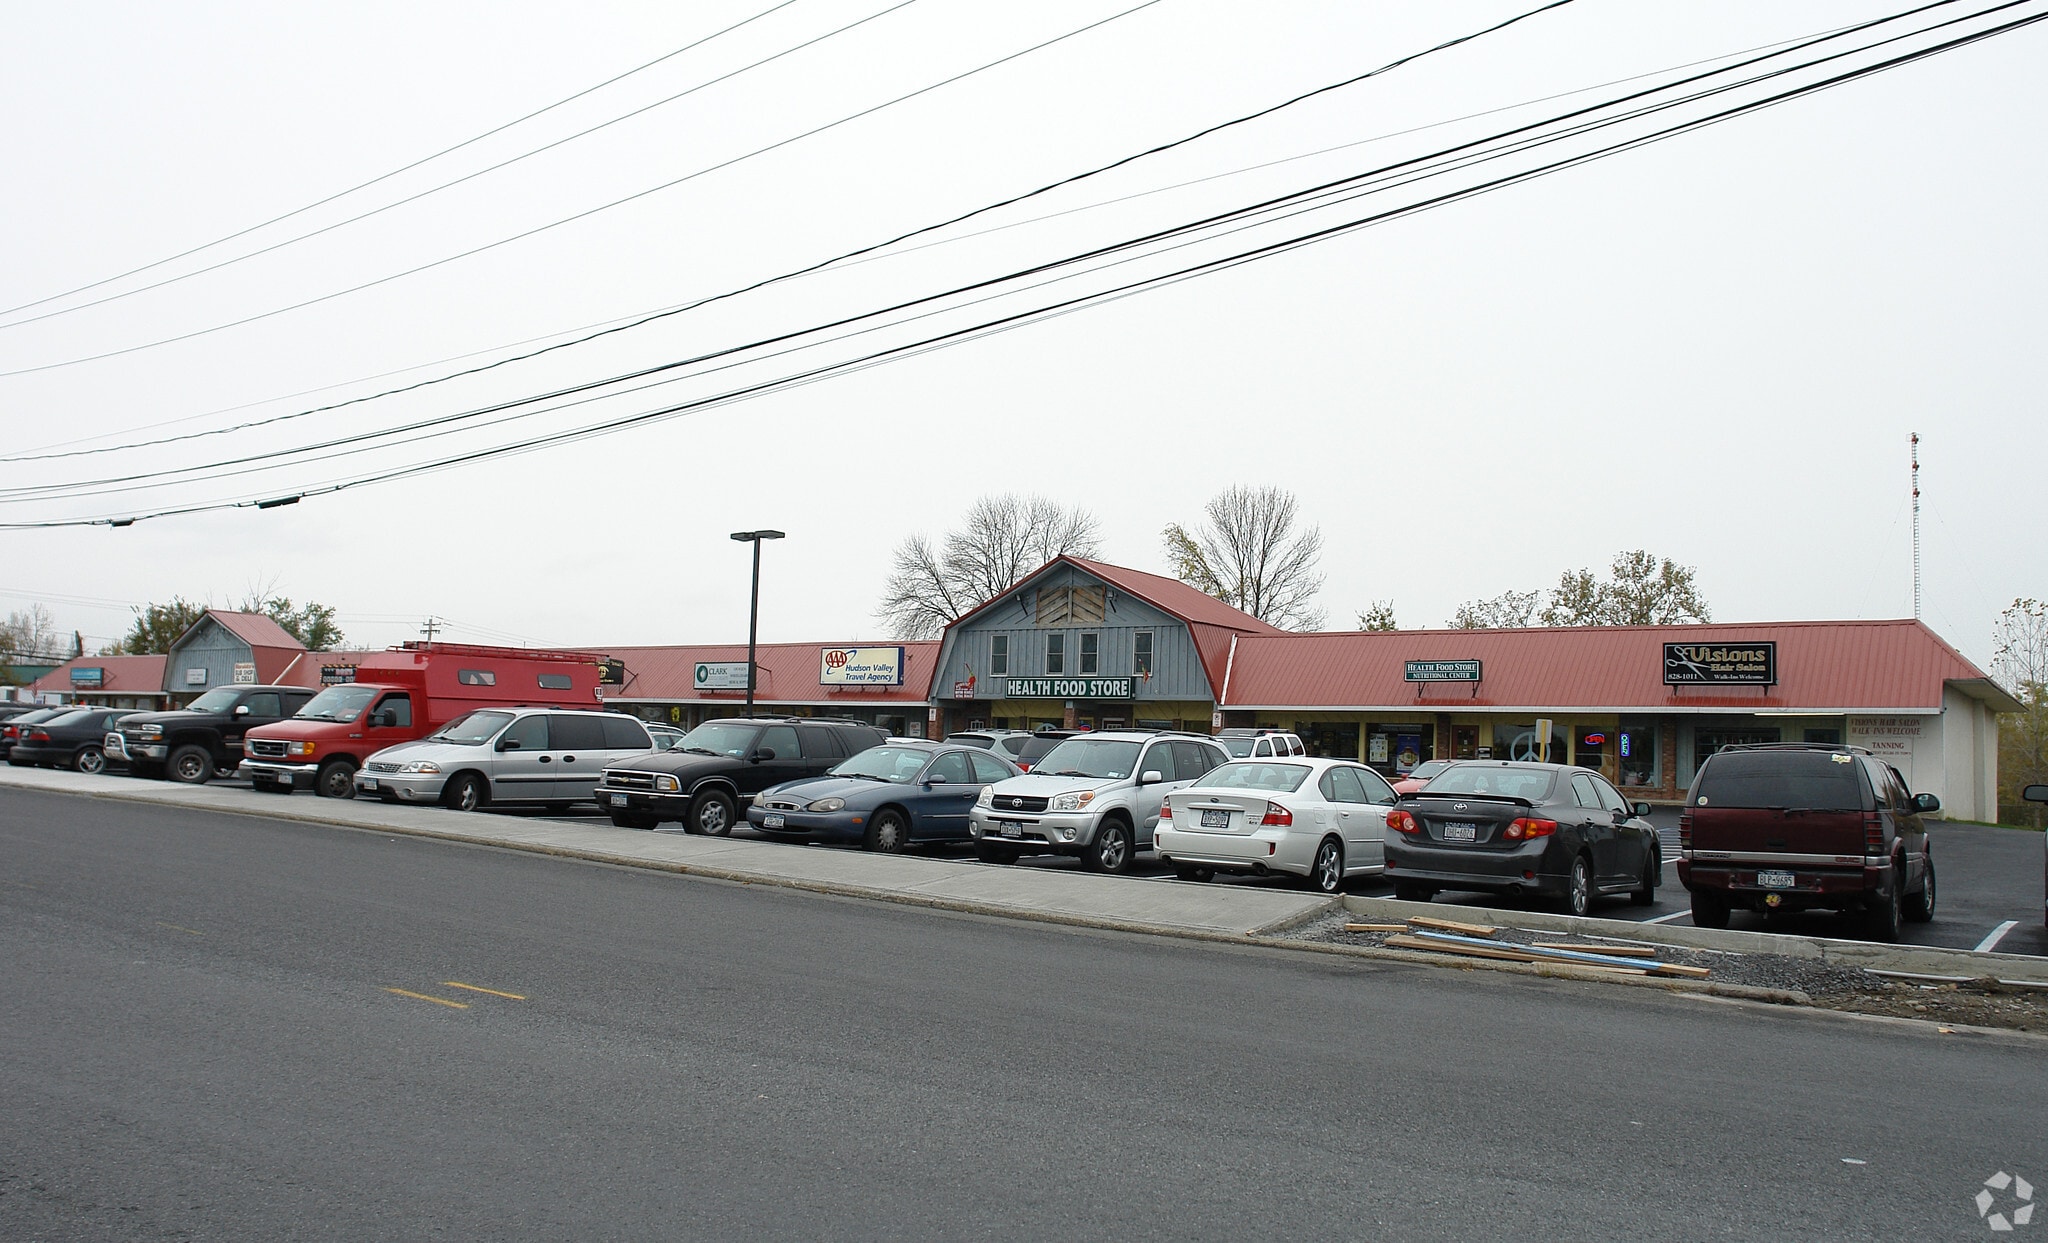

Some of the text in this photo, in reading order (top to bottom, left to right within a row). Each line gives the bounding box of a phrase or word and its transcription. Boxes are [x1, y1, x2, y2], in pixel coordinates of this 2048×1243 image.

[1684, 646, 1766, 662] Visions
[826, 652, 847, 667] AAA
[708, 667, 728, 676] CLARK
[845, 663, 895, 674] Hudson Valley
[1407, 663, 1477, 671] HEALTH FOOD STORE
[1710, 663, 1766, 671] Hair Salon
[845, 673, 894, 682] Travel Agency
[1007, 680, 1129, 697] HEALTH FOOD STORE
[1585, 735, 1605, 744] OPEN
